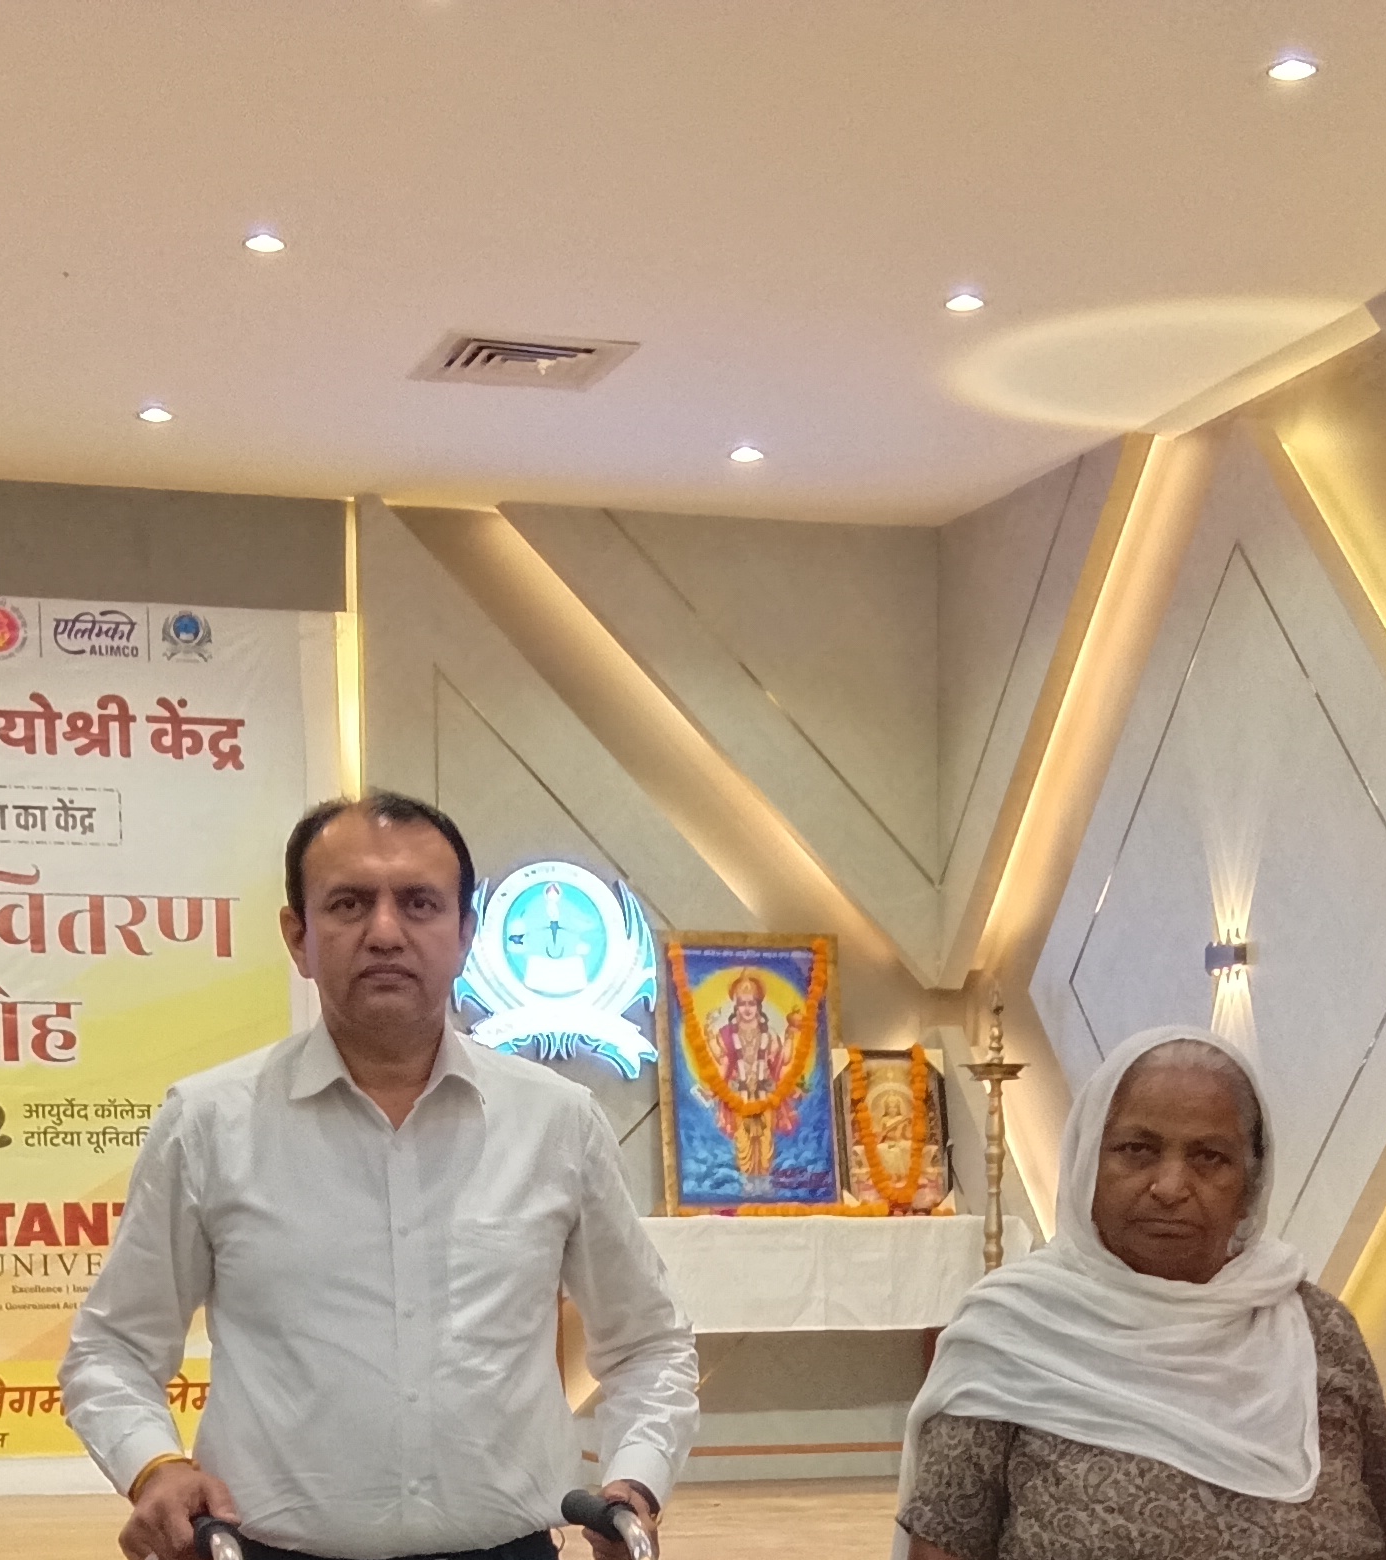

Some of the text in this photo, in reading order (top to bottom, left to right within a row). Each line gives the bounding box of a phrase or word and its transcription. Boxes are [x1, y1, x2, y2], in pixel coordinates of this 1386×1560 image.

[89, 645, 139, 658] ALIMCO
[146, 697, 245, 771] केंद्र
[13, 802, 48, 833] का
[53, 797, 96, 836] केंद्र
[23, 1098, 152, 1126] आयुर्वेद कॉलेज
[23, 1126, 82, 1147] टांटिया
